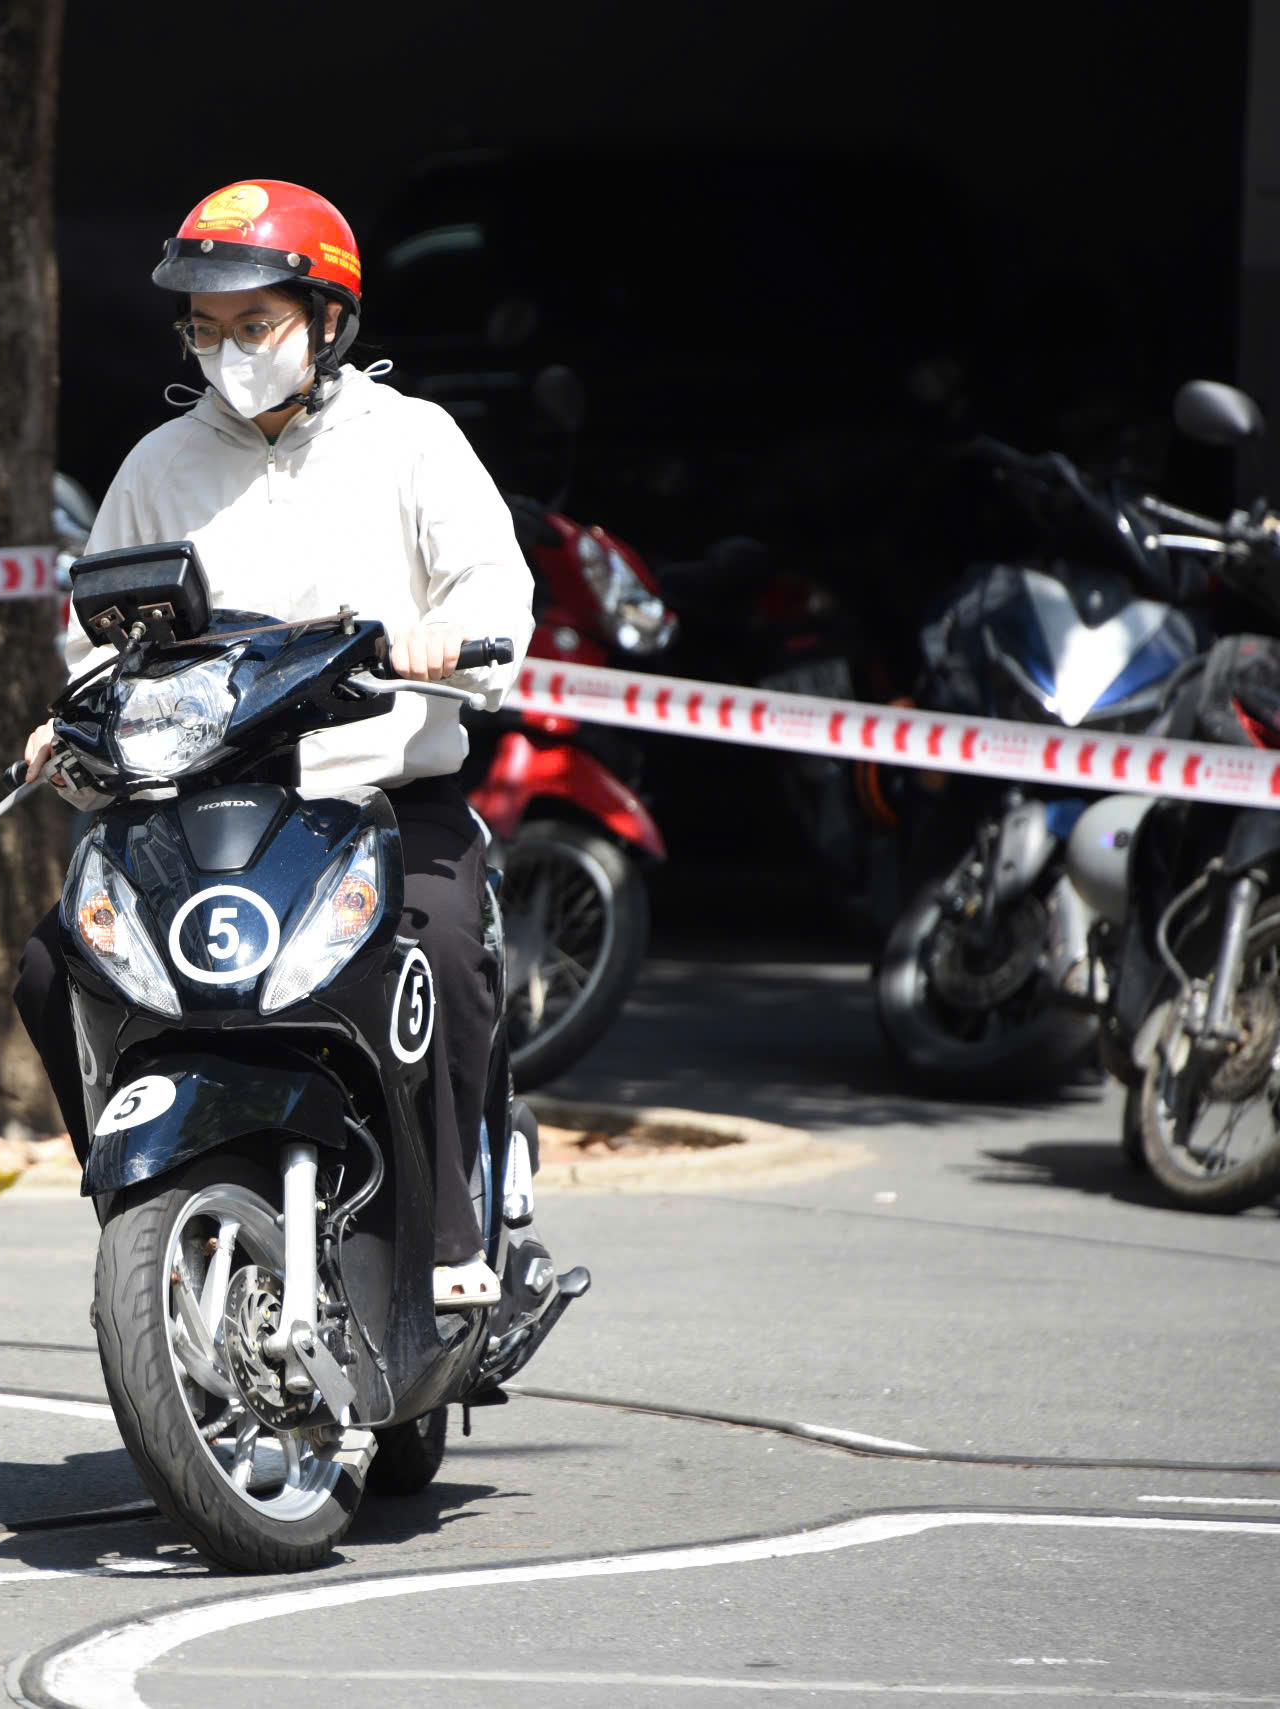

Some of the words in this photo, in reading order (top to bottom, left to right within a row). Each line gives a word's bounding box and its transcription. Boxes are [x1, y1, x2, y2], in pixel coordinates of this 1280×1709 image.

[197, 800, 258, 812] HONDA
[208, 908, 240, 959] 5
[409, 976, 423, 1035] 5
[114, 1085, 149, 1120] 5
